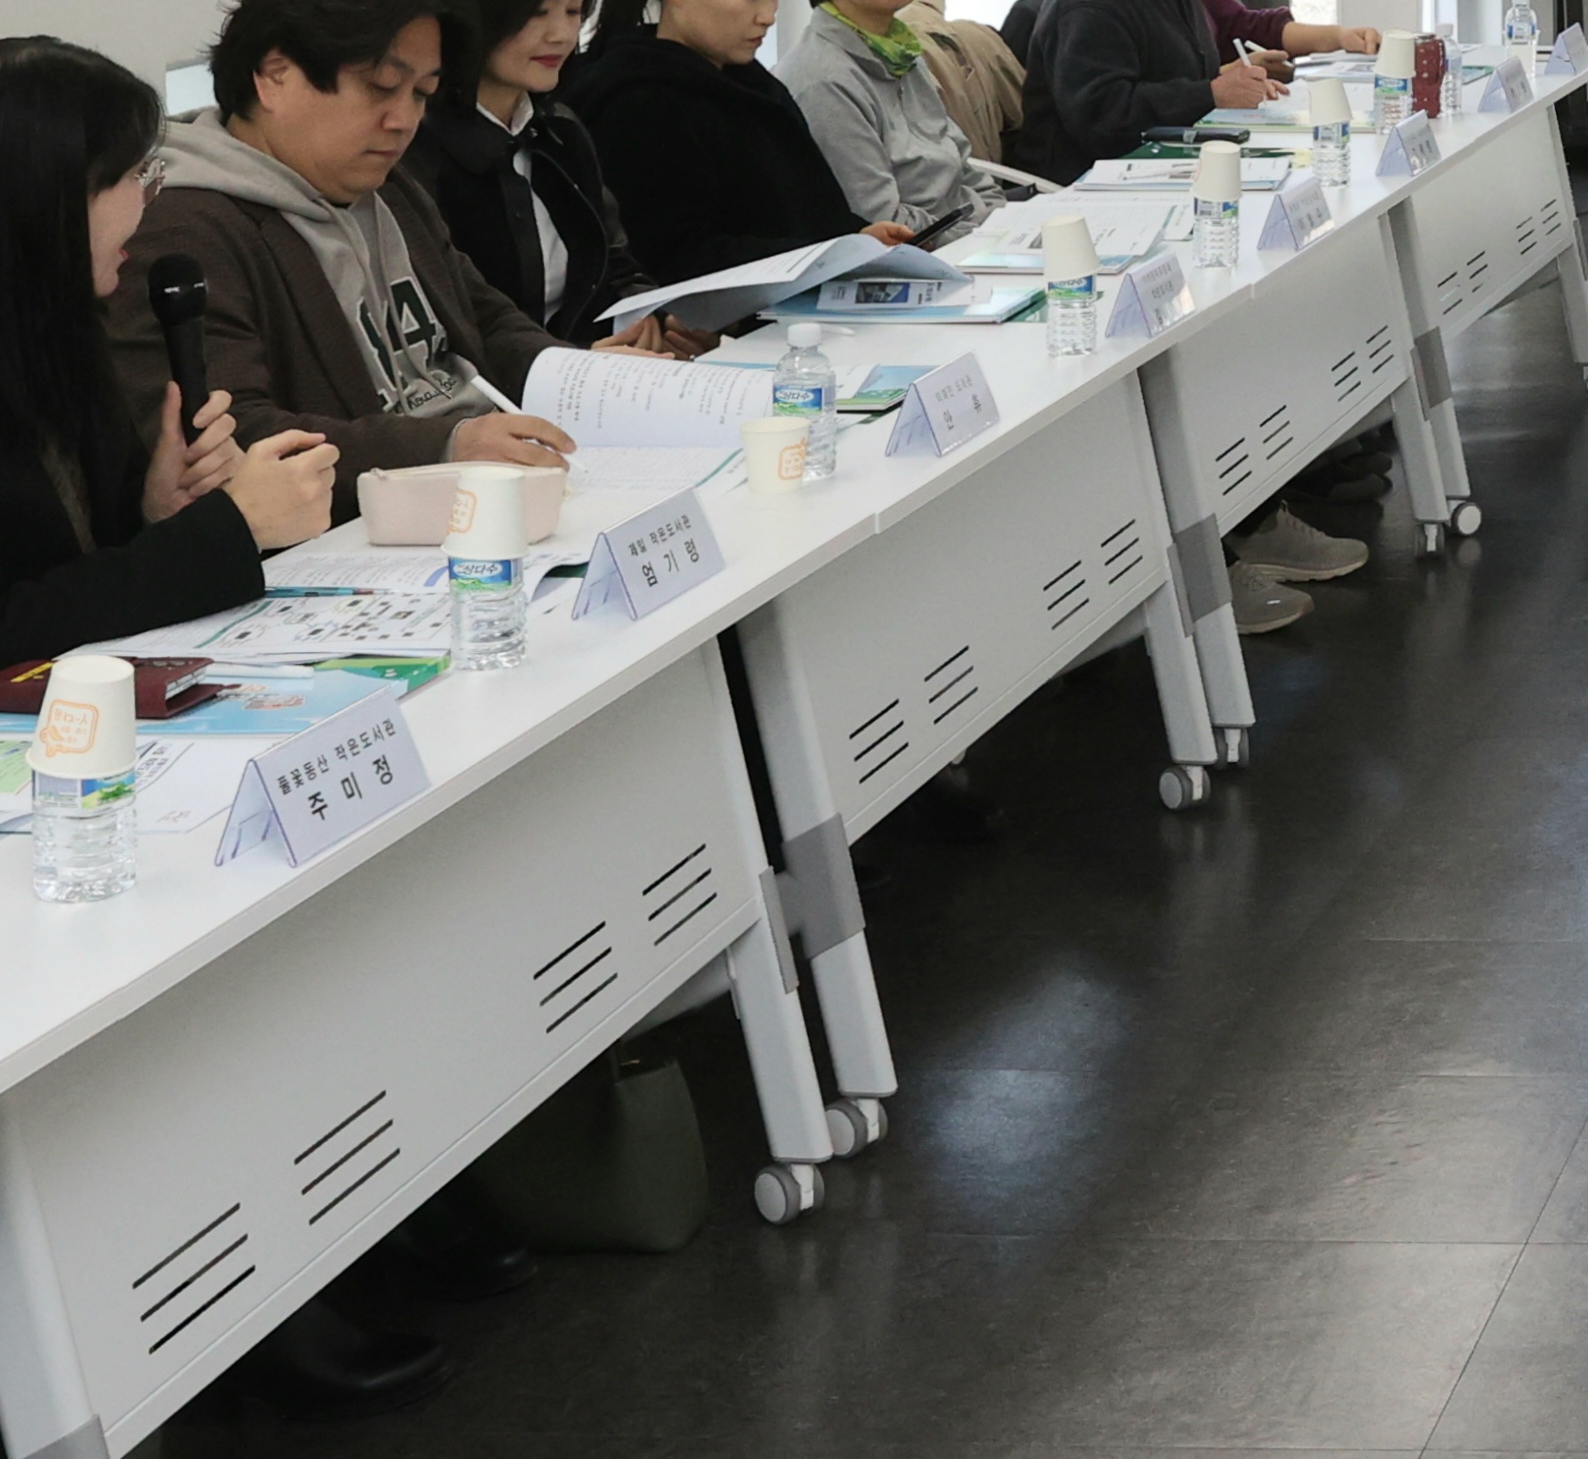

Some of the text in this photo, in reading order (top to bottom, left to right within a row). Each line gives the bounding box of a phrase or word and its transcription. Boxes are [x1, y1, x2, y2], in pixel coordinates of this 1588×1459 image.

[649, 514, 692, 544] 작은도서관
[277, 718, 397, 795] 풀꽃동산 작은도서관
